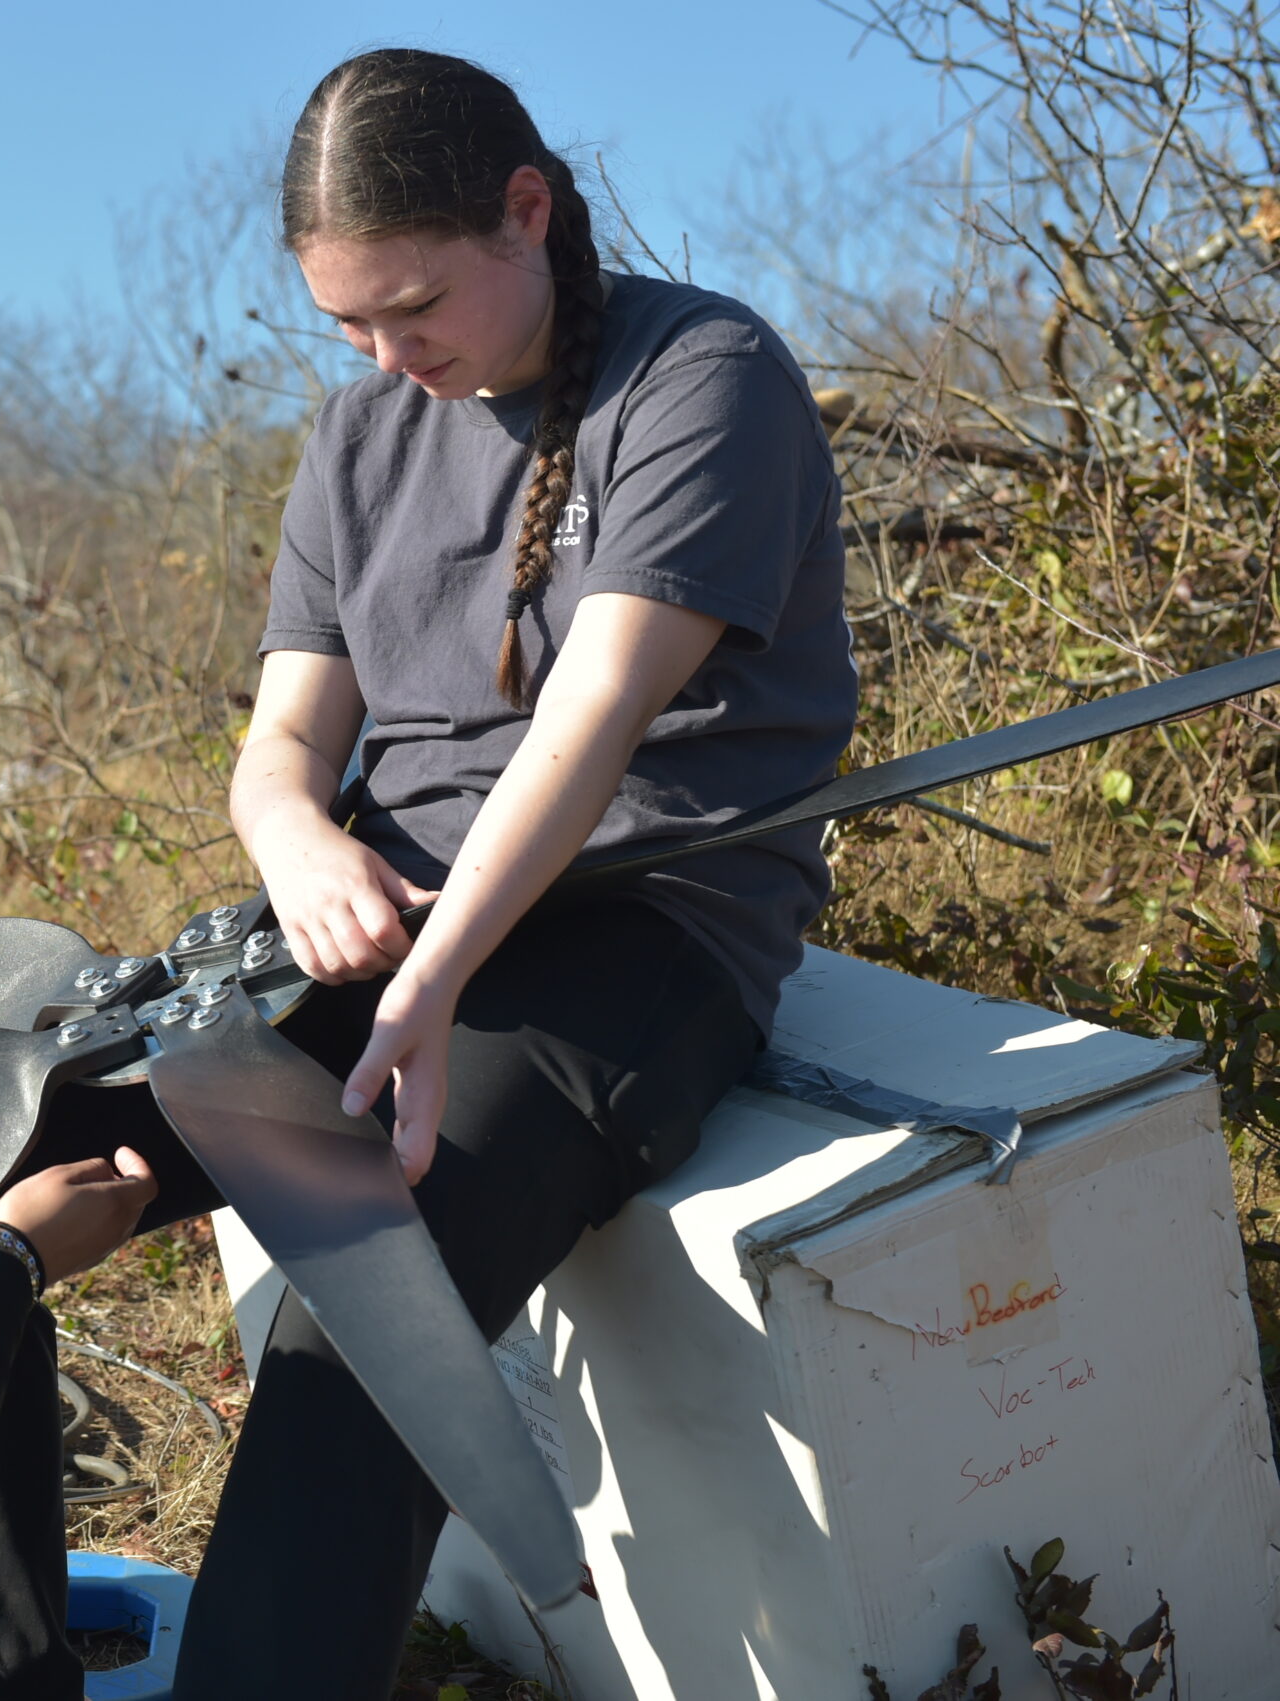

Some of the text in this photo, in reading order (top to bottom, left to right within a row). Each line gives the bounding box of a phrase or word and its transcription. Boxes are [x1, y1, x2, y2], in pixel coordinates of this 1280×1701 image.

[911, 1272, 1068, 1361] New Bedford
[957, 1435, 1059, 1504] Scorbot
